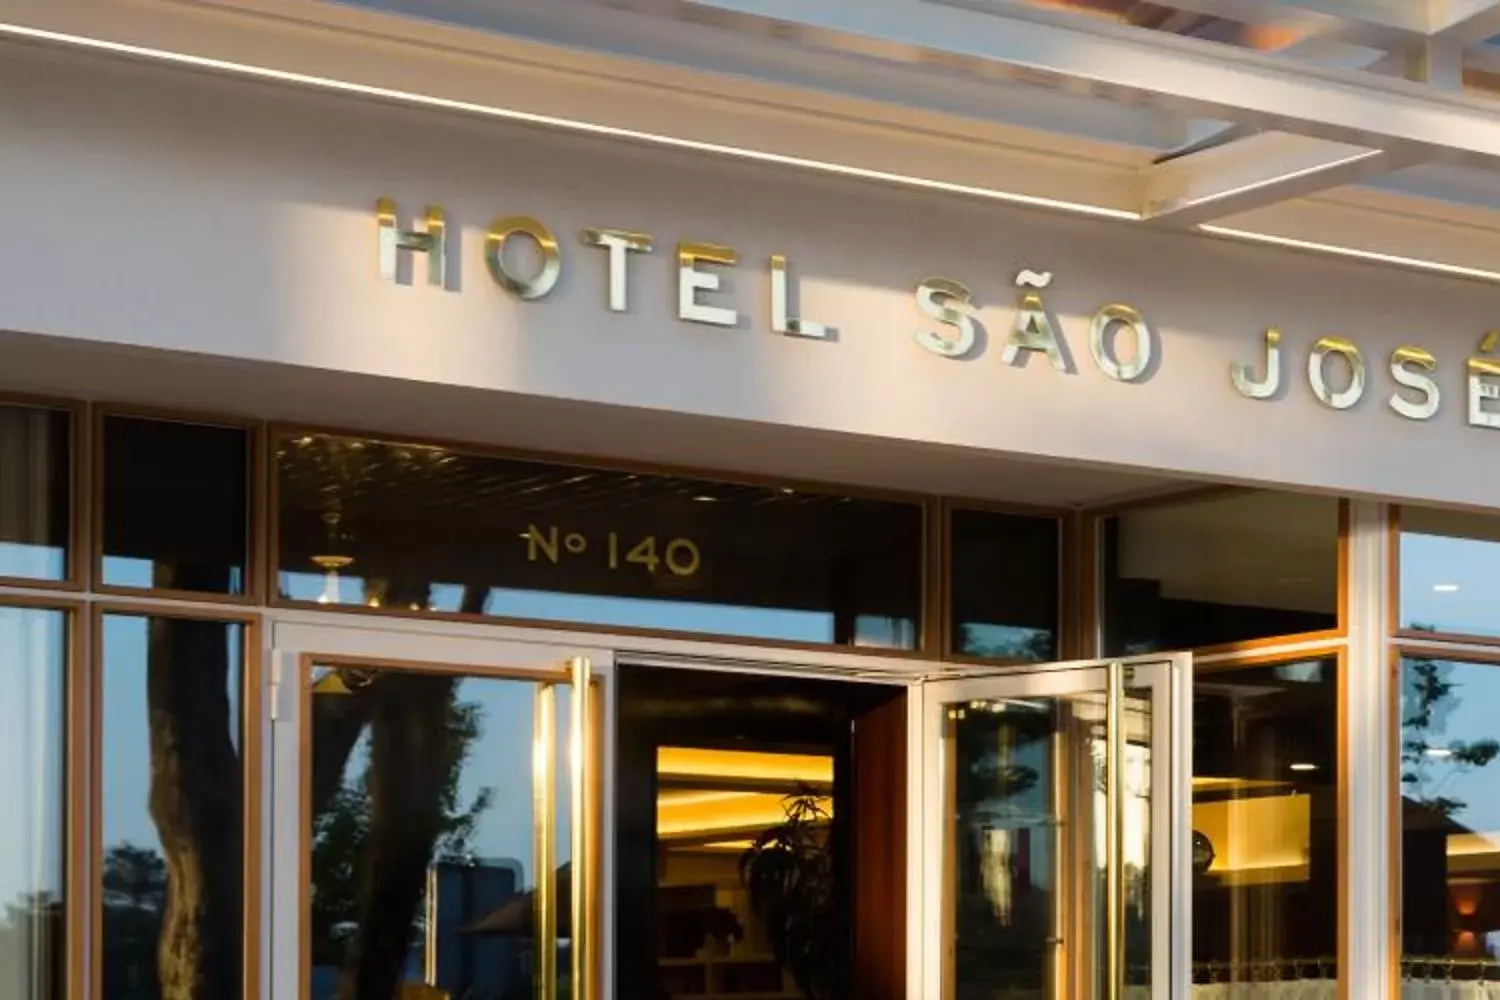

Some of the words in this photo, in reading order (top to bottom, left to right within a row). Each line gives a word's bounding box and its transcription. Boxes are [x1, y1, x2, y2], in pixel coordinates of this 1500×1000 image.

[374, 195, 826, 338] HOTEL
[913, 269, 1152, 382] SÃO
[608, 532, 700, 575] 140
